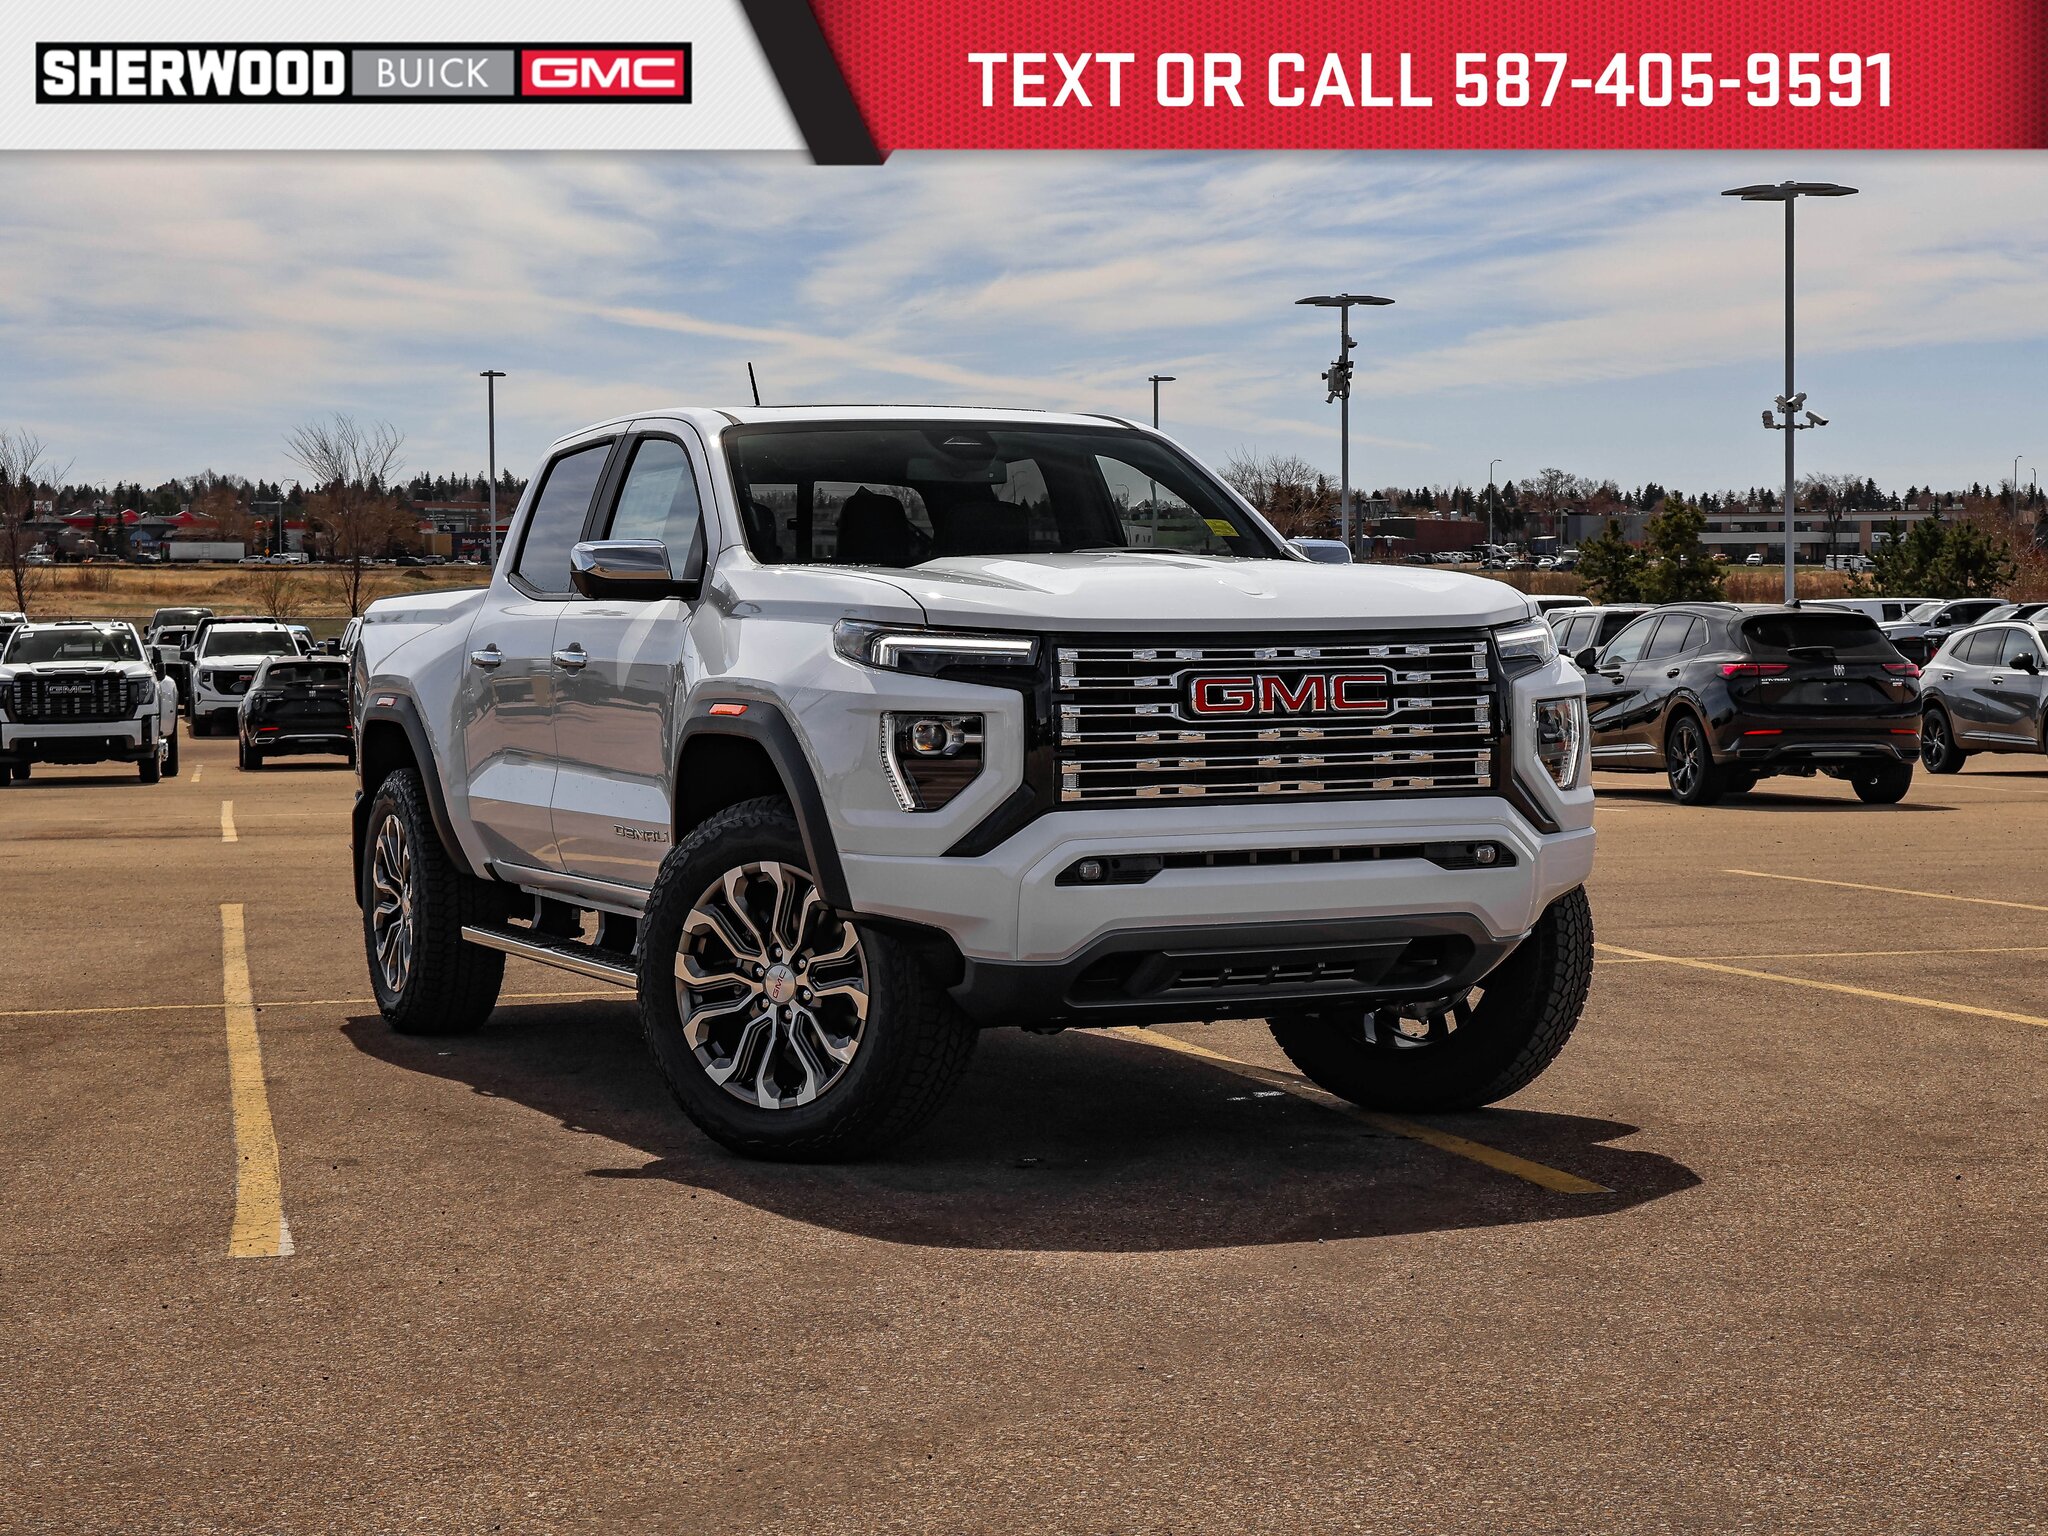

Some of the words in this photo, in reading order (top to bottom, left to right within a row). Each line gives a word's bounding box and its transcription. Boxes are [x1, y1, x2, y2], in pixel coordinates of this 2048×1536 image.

[49, 685, 92, 695] GMC
[1191, 673, 1389, 714] GMC
[613, 823, 670, 843] DENALI
[772, 968, 787, 999] GMC
